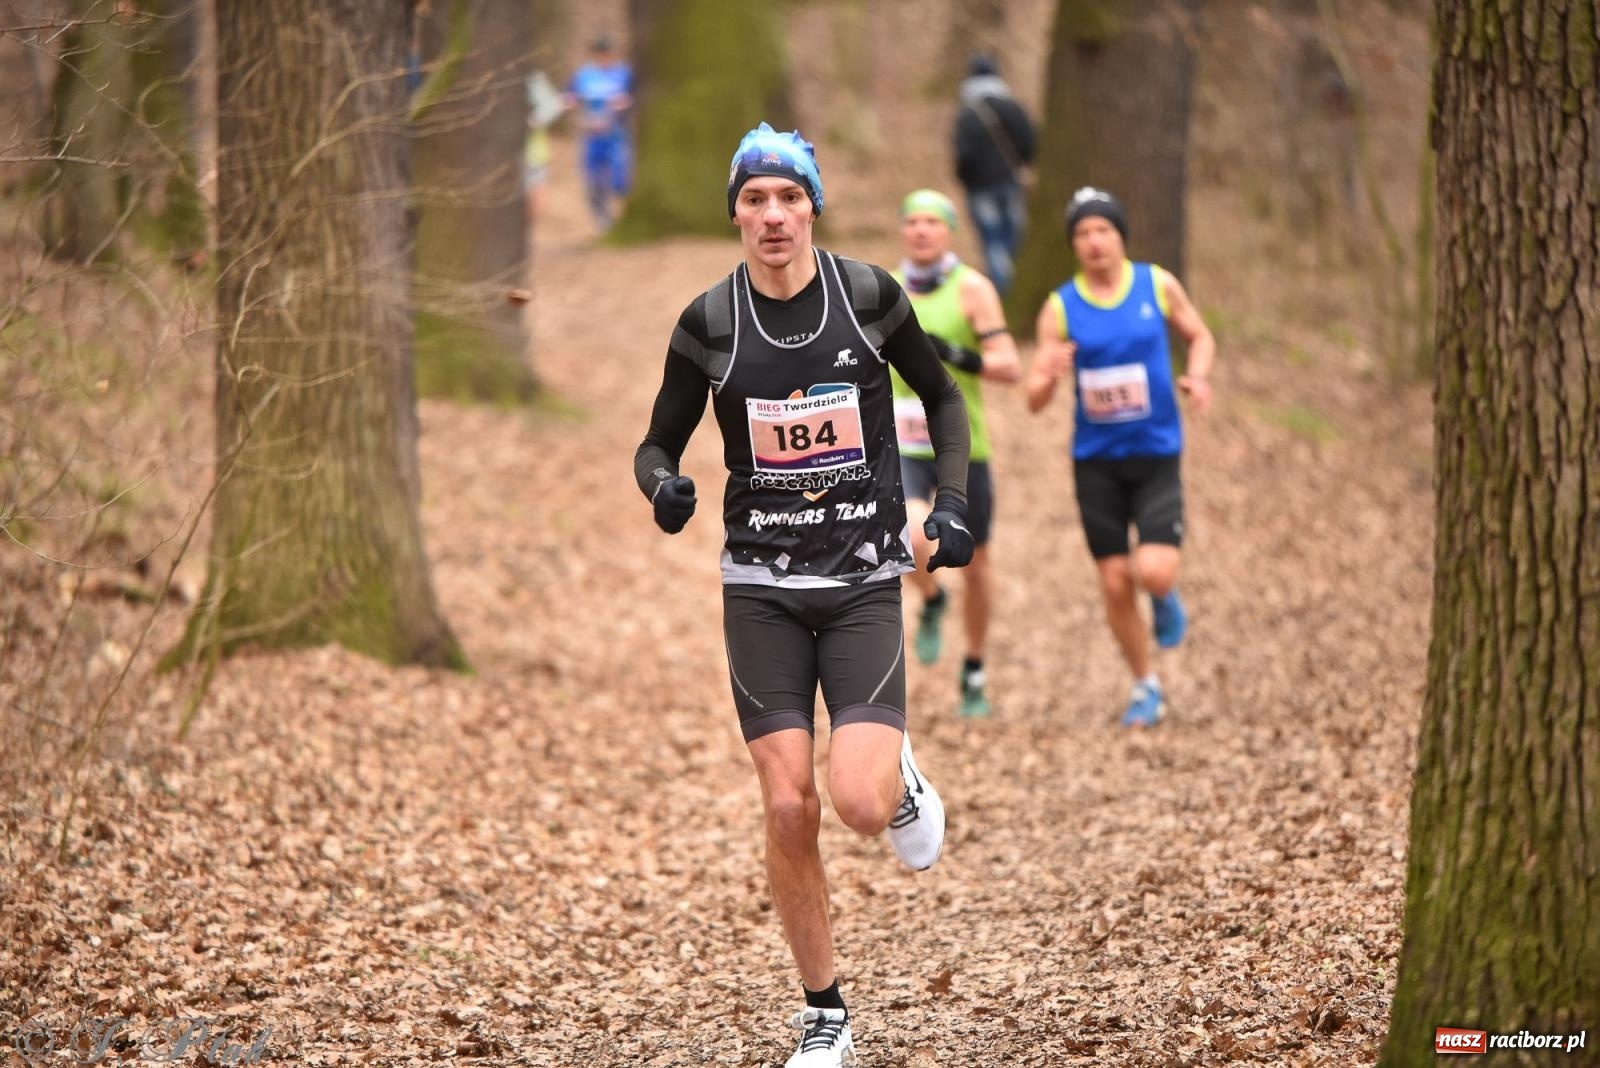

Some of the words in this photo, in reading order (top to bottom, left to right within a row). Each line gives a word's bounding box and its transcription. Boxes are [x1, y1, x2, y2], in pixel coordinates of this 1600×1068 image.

[756, 402, 781, 412] BIEG
[783, 394, 848, 411] Twardziela
[773, 420, 838, 451] 184
